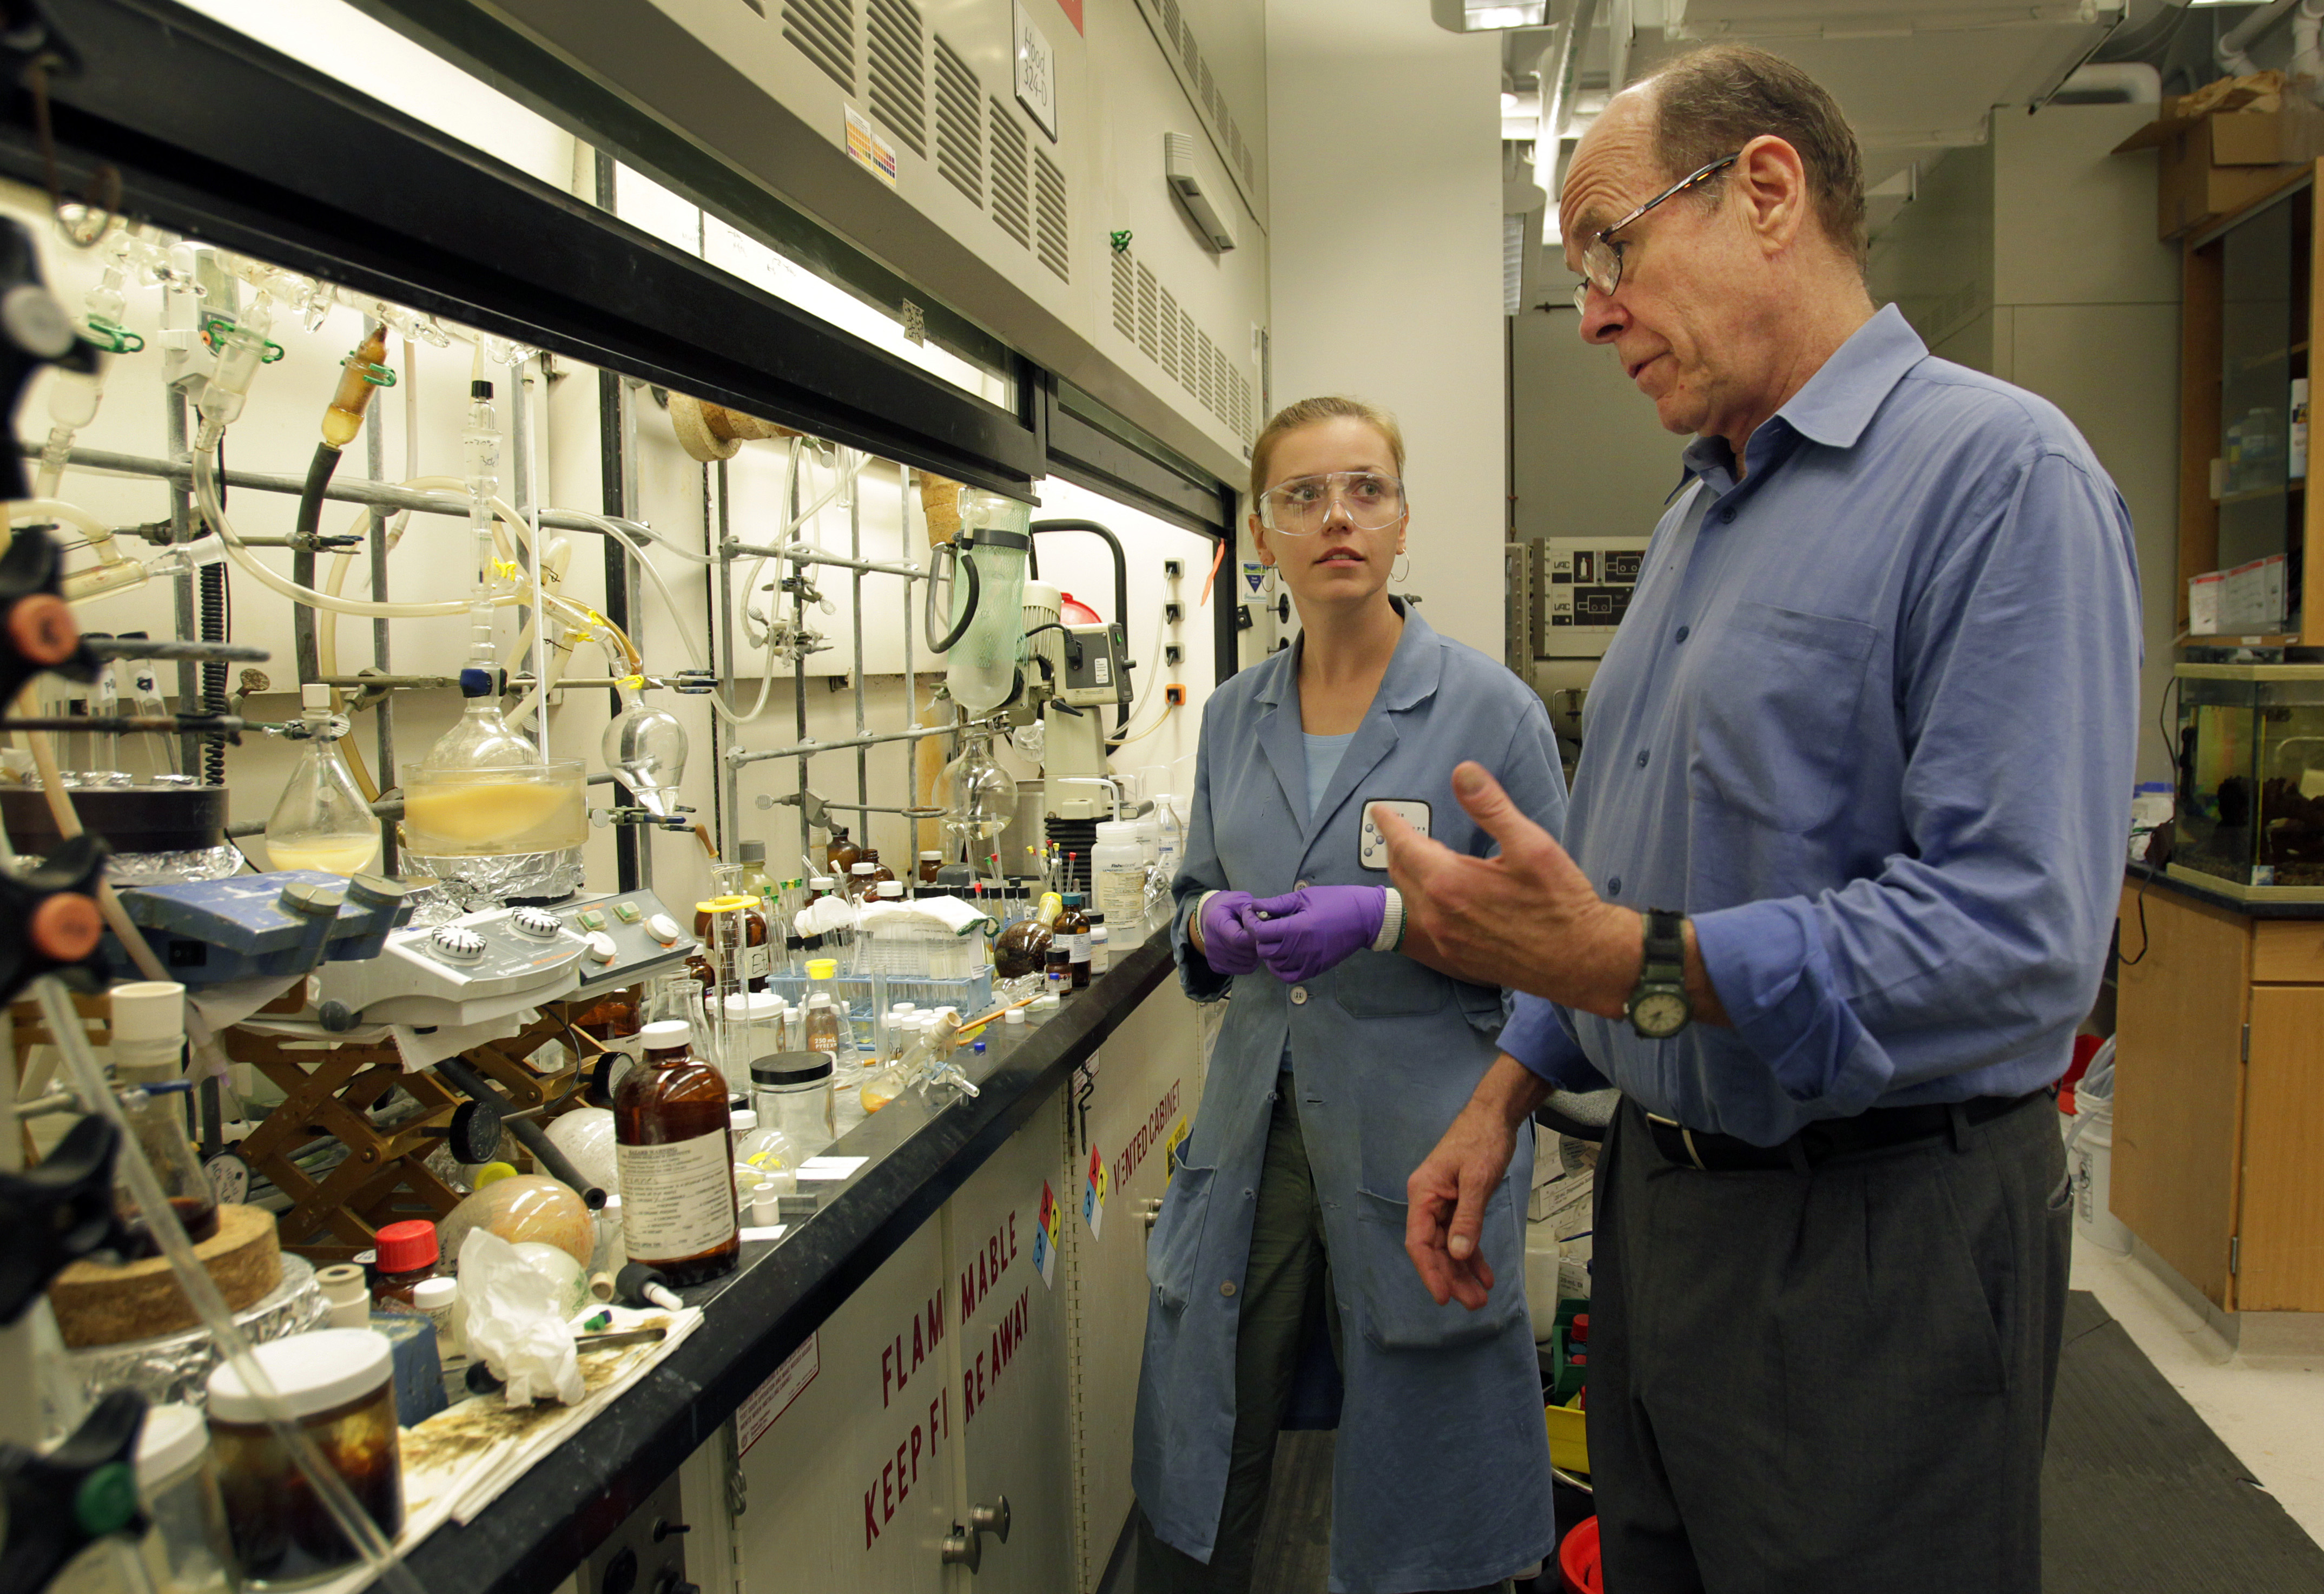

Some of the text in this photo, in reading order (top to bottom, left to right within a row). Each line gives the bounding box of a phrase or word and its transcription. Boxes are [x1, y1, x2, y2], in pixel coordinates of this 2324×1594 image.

[1025, 27, 1045, 76] Hood
[1024, 58, 1047, 107] 324-D
[1554, 603, 1570, 611] VAC
[1113, 1078, 1180, 1196] VENTED CABINET
[1086, 1190, 1091, 1218] 3
[1099, 1173, 1104, 1200] 2
[1036, 1231, 1042, 1264] 3
[1052, 1208, 1058, 1239] 2
[961, 1210, 1018, 1326] MABLE
[882, 1288, 945, 1409] FLAM
[865, 1424, 923, 1551] KEEP
[992, 1286, 1029, 1386] AWAY
